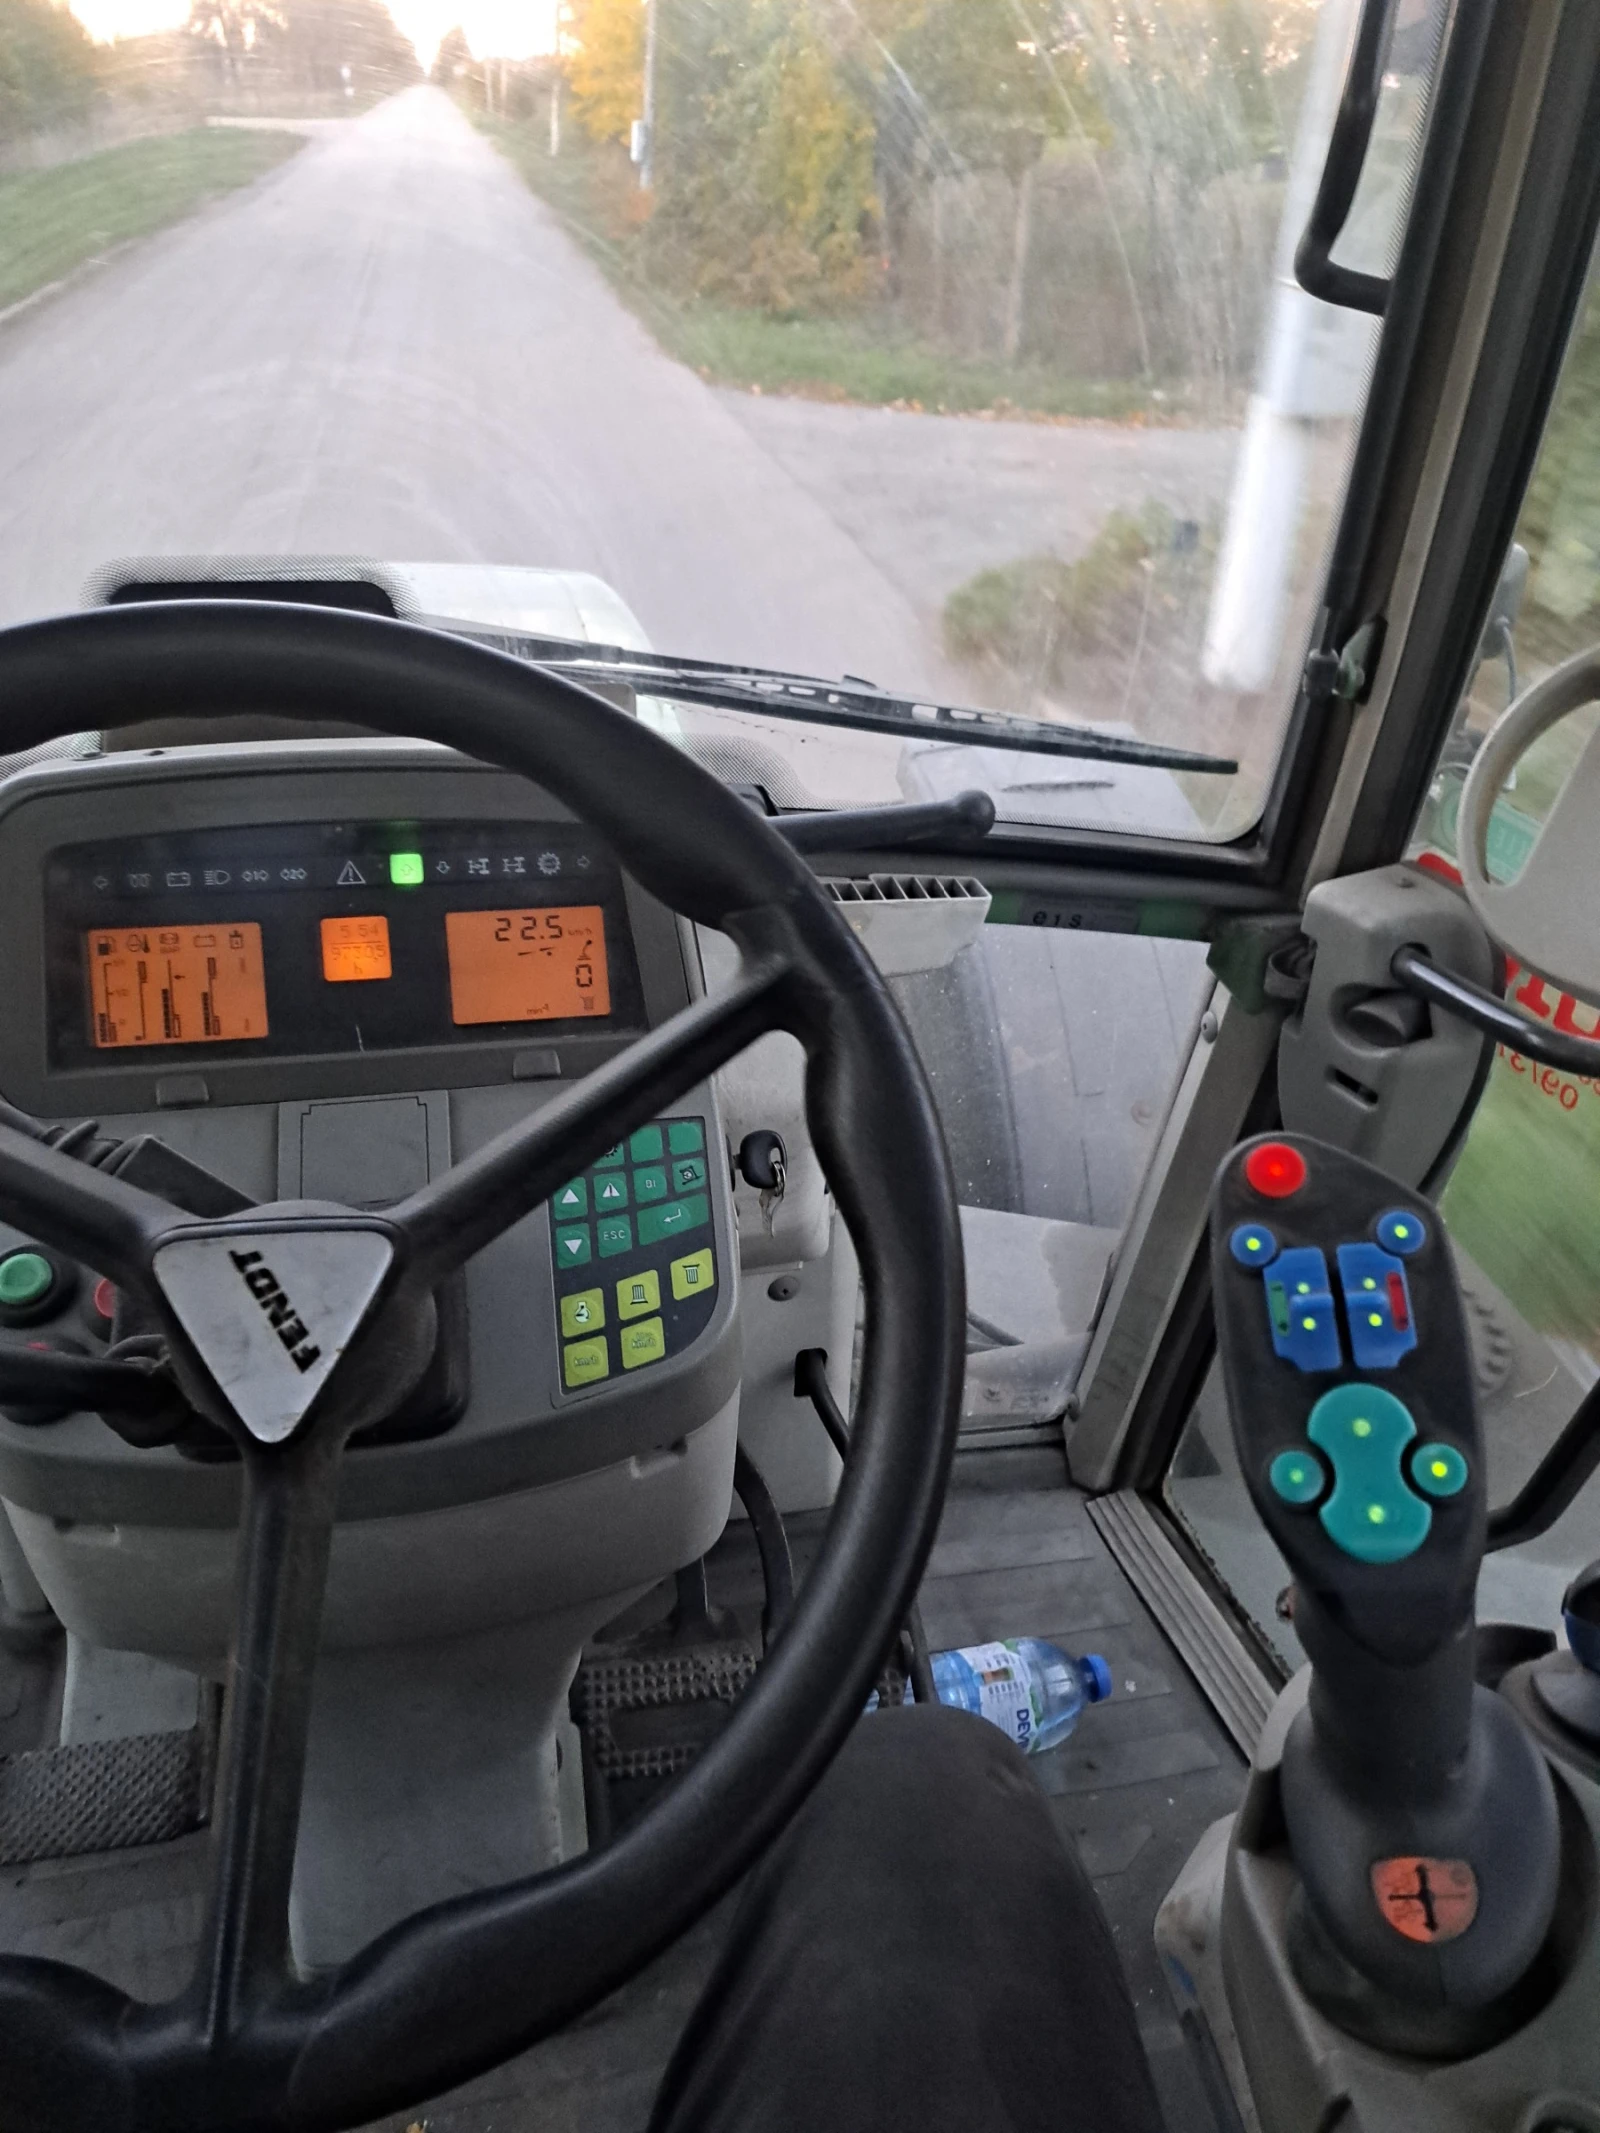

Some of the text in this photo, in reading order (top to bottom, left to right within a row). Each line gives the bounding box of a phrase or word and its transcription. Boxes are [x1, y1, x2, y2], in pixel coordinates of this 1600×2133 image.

[495, 915, 562, 942] 22.5
[603, 1229, 626, 1241] ESC
[228, 1250, 321, 1374] FENDT
